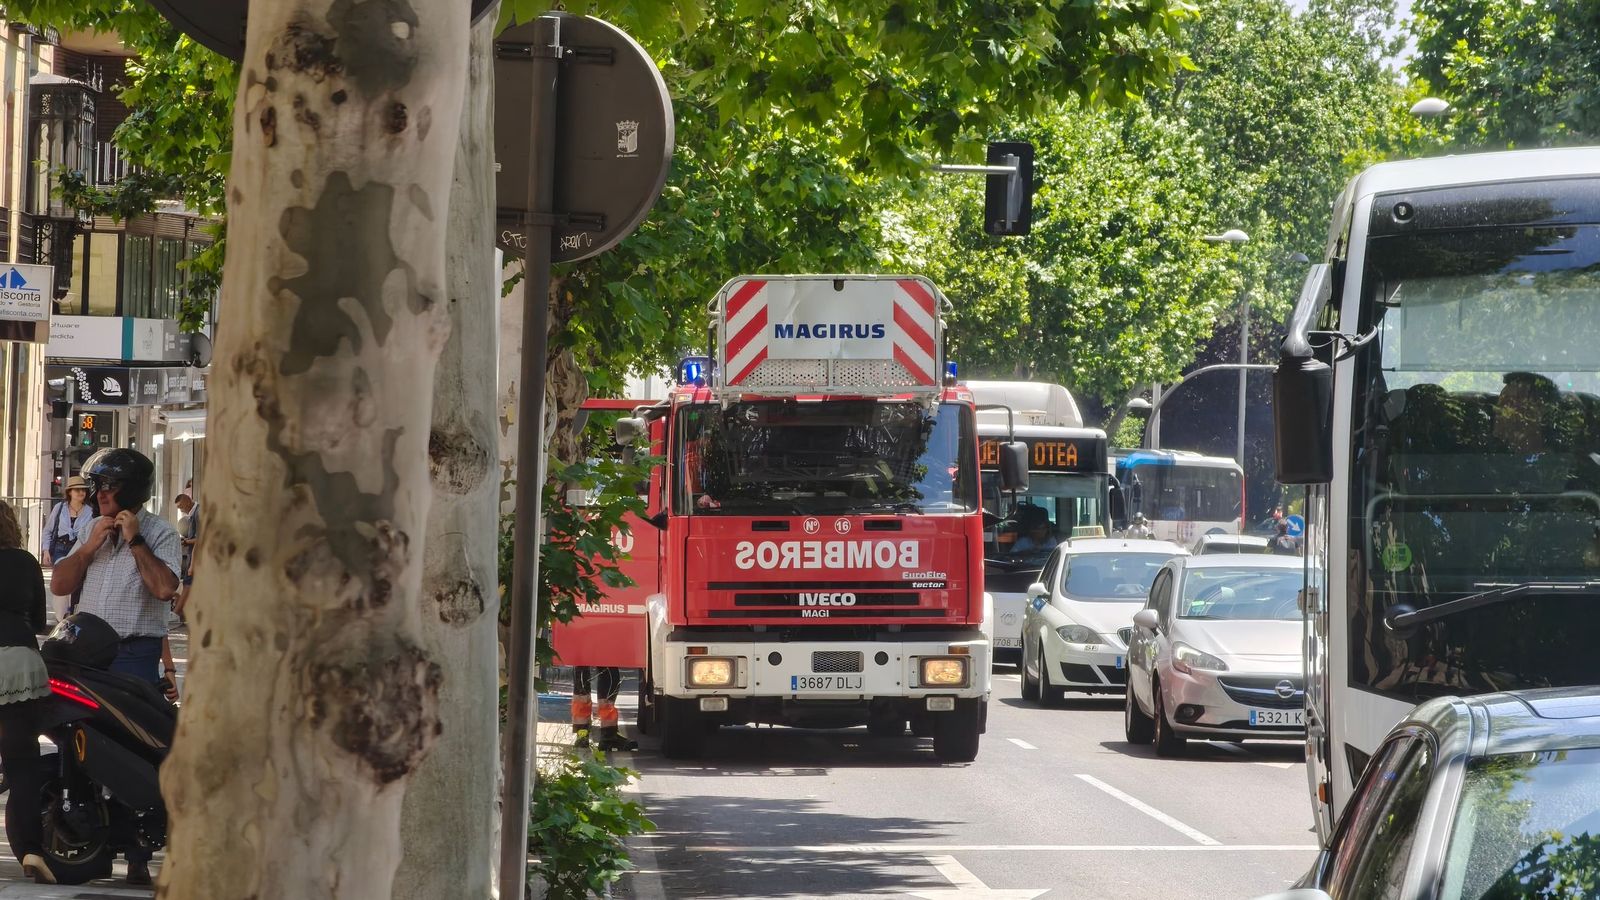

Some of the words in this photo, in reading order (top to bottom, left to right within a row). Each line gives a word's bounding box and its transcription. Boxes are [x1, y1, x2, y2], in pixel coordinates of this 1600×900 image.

[774, 323, 886, 339] MAGIRUS
[1034, 441, 1078, 467] OTEA
[836, 520, 849, 531] 16
[798, 592, 857, 606] IVECO
[801, 609, 830, 618] MAGI
[799, 676, 833, 689] 3687
[836, 676, 862, 689] DLJ
[1258, 711, 1290, 724] 5321
[1294, 712, 1303, 724] K
